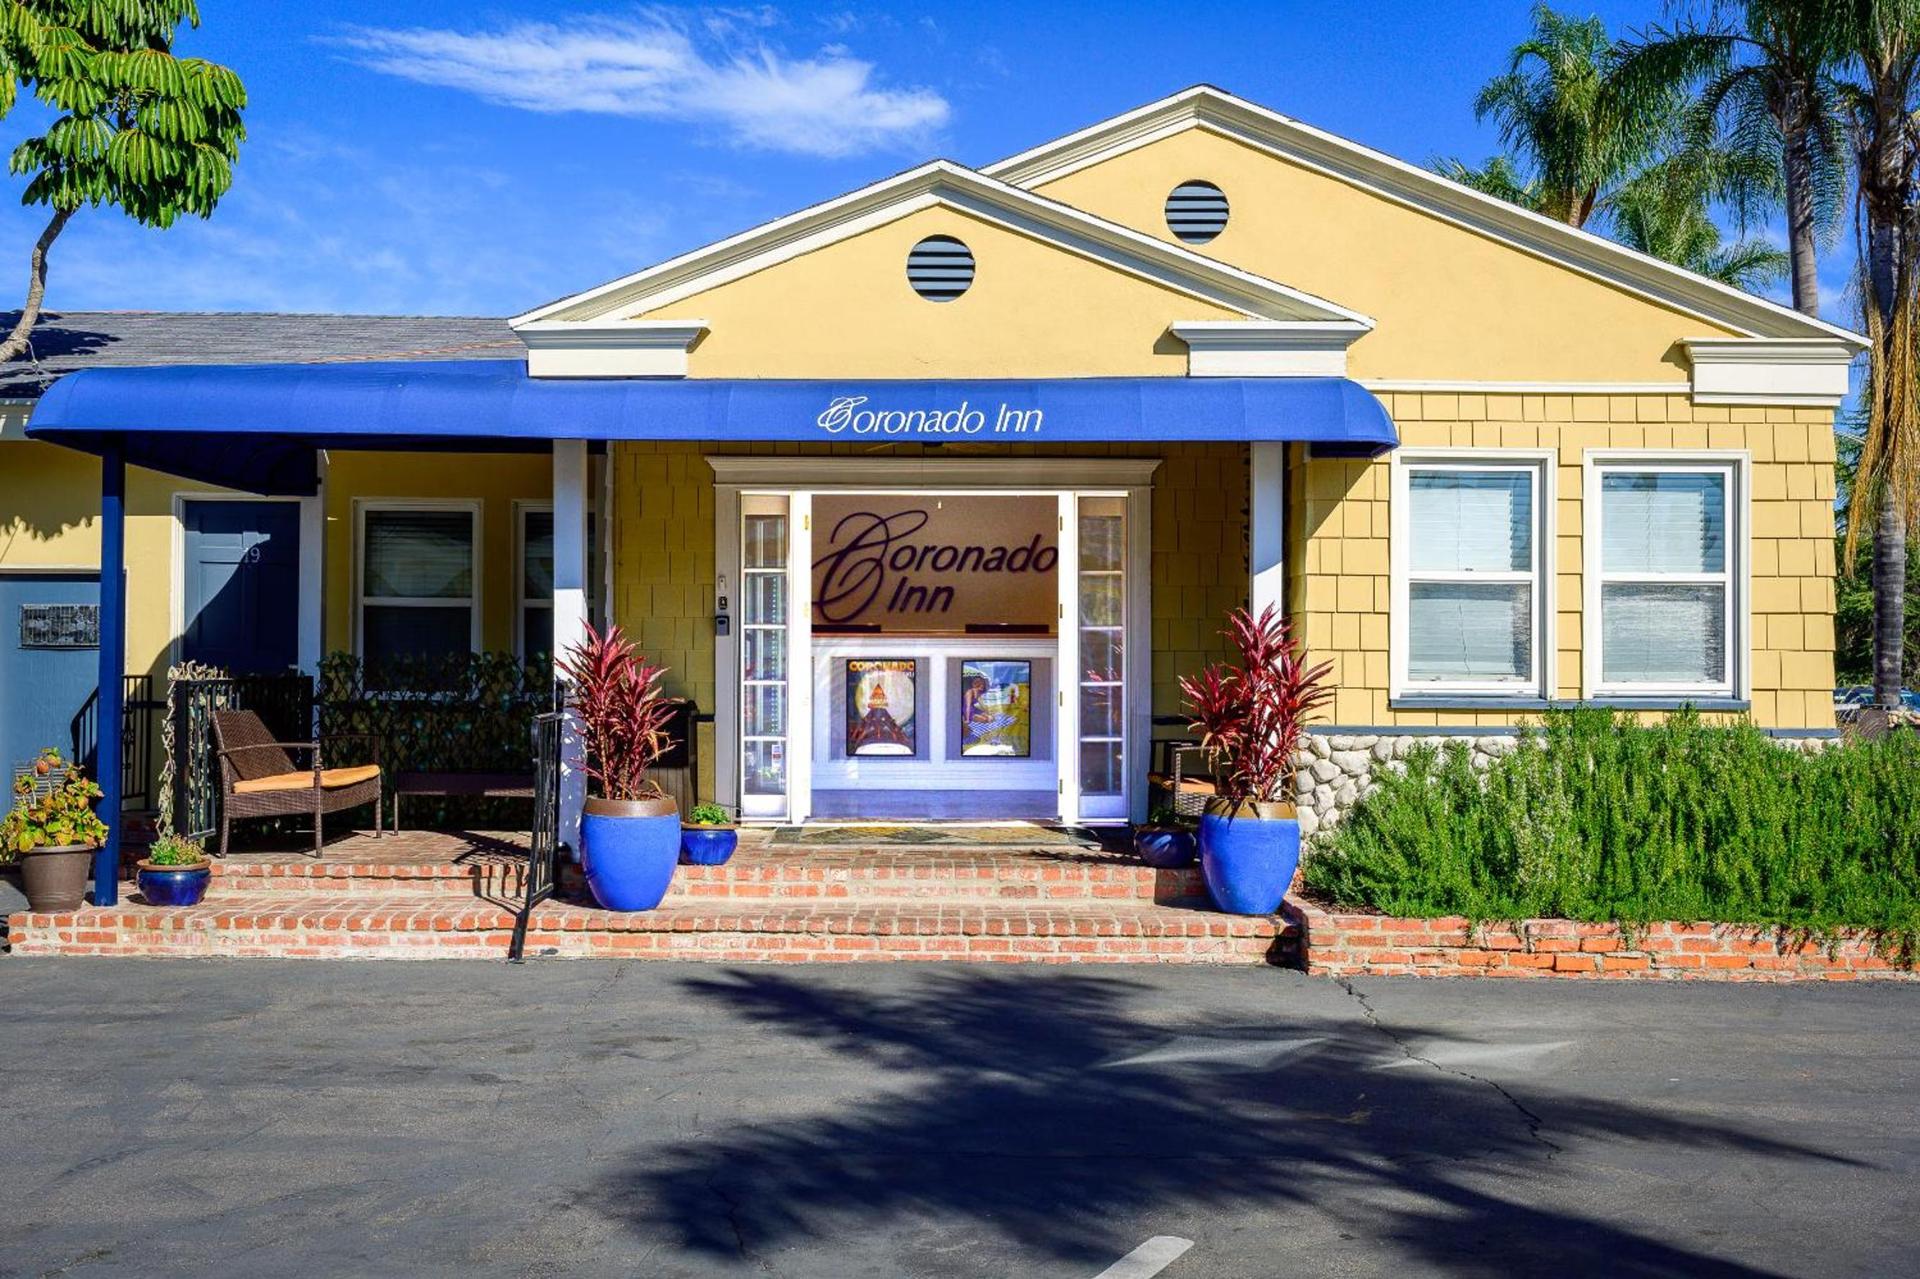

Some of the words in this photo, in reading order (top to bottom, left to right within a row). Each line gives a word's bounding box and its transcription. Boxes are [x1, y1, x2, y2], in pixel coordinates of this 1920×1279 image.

[817, 396, 985, 434] Coronado
[994, 403, 1043, 433] Inn
[811, 510, 1058, 623] Coronado
[887, 576, 954, 612] Inn
